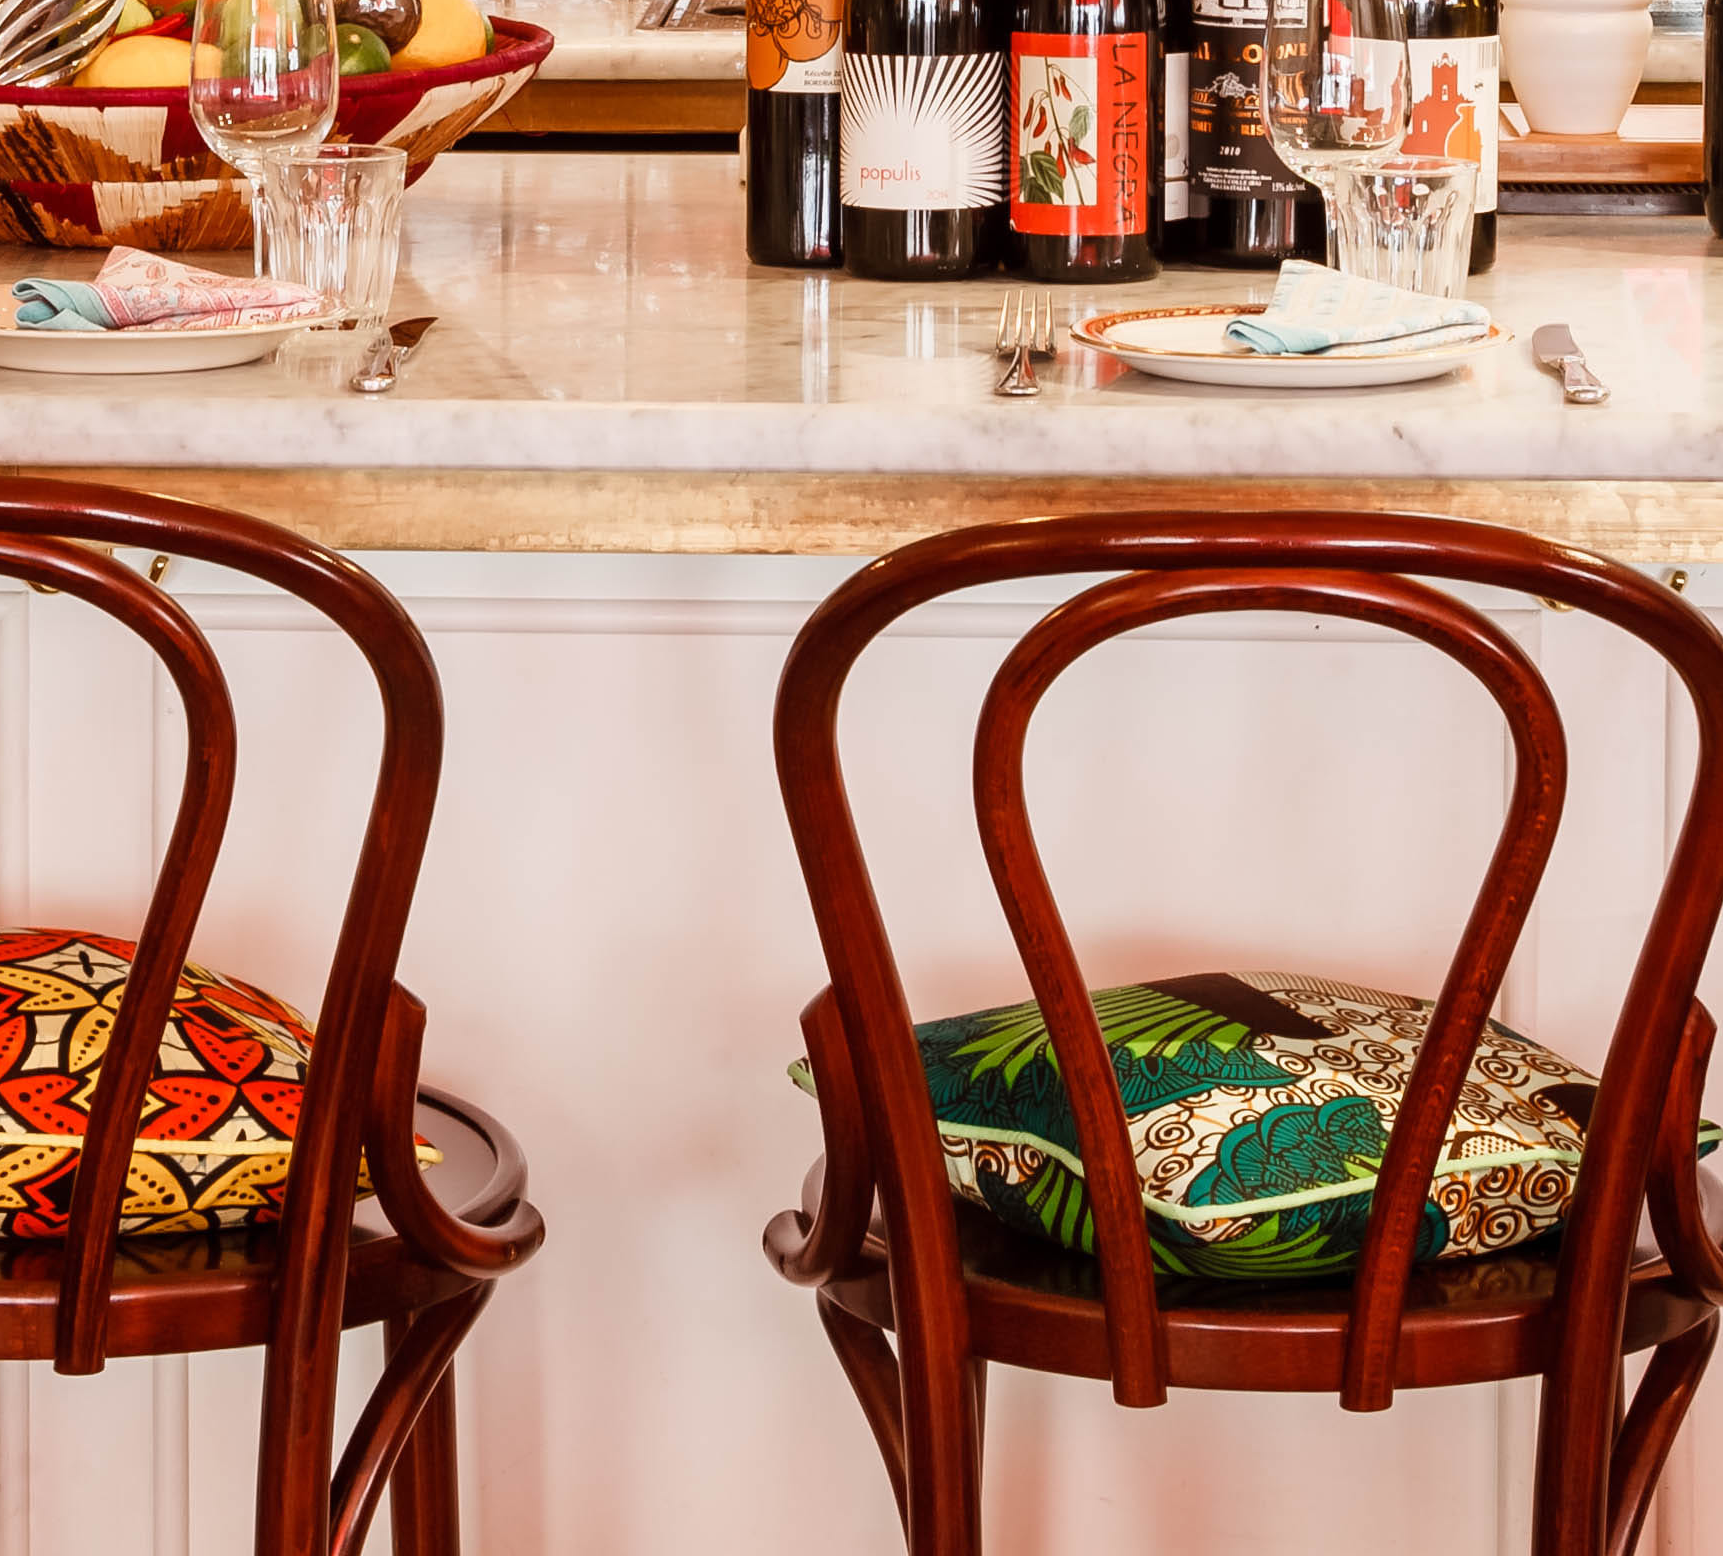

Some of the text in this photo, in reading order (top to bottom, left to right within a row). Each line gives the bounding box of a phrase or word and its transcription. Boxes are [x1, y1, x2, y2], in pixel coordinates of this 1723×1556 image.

[860, 159, 922, 191] populis
[1111, 44, 1139, 226] LA NEGRA
